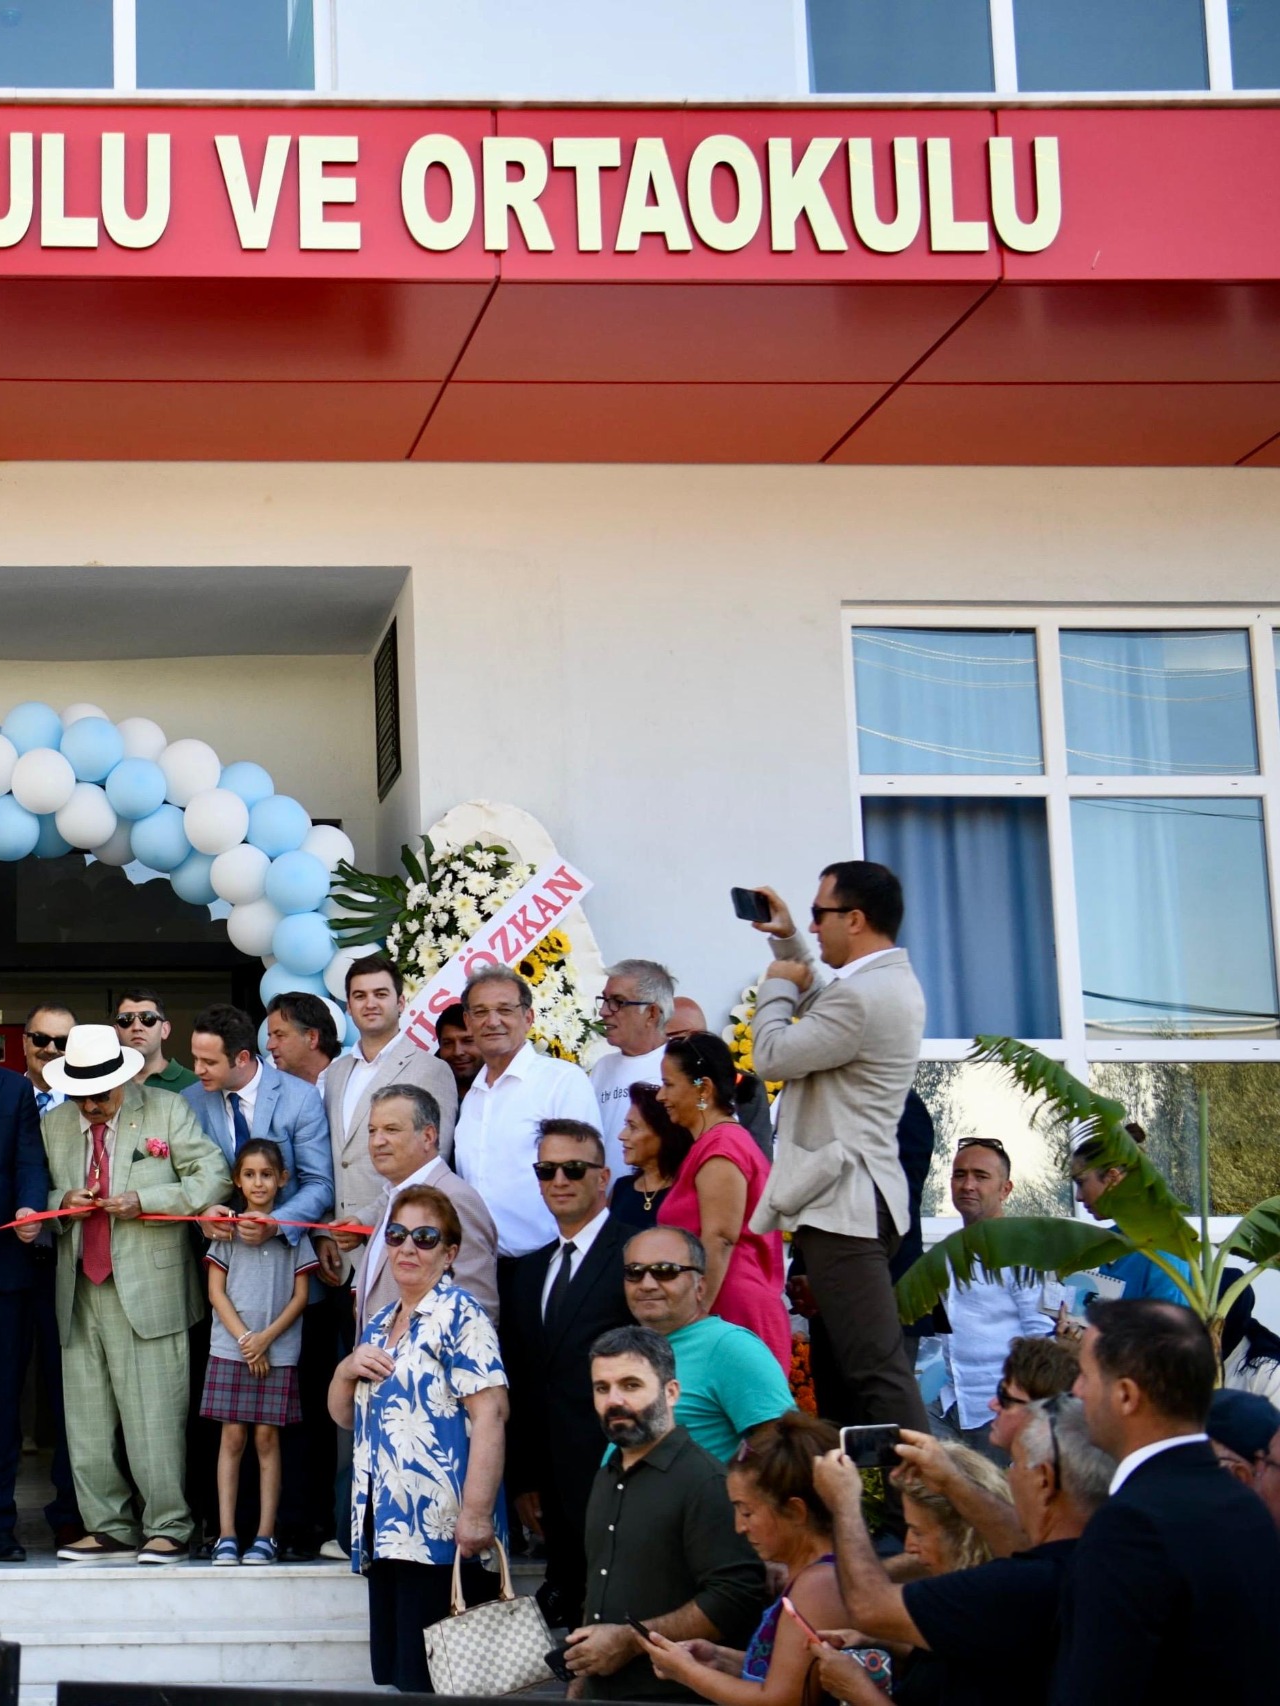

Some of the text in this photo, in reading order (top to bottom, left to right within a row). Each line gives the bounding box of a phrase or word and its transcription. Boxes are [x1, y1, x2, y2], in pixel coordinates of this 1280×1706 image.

[214, 135, 361, 249] VE
[402, 134, 1062, 252] ORTAOKULU
[458, 865, 584, 978] ÖZKAN
